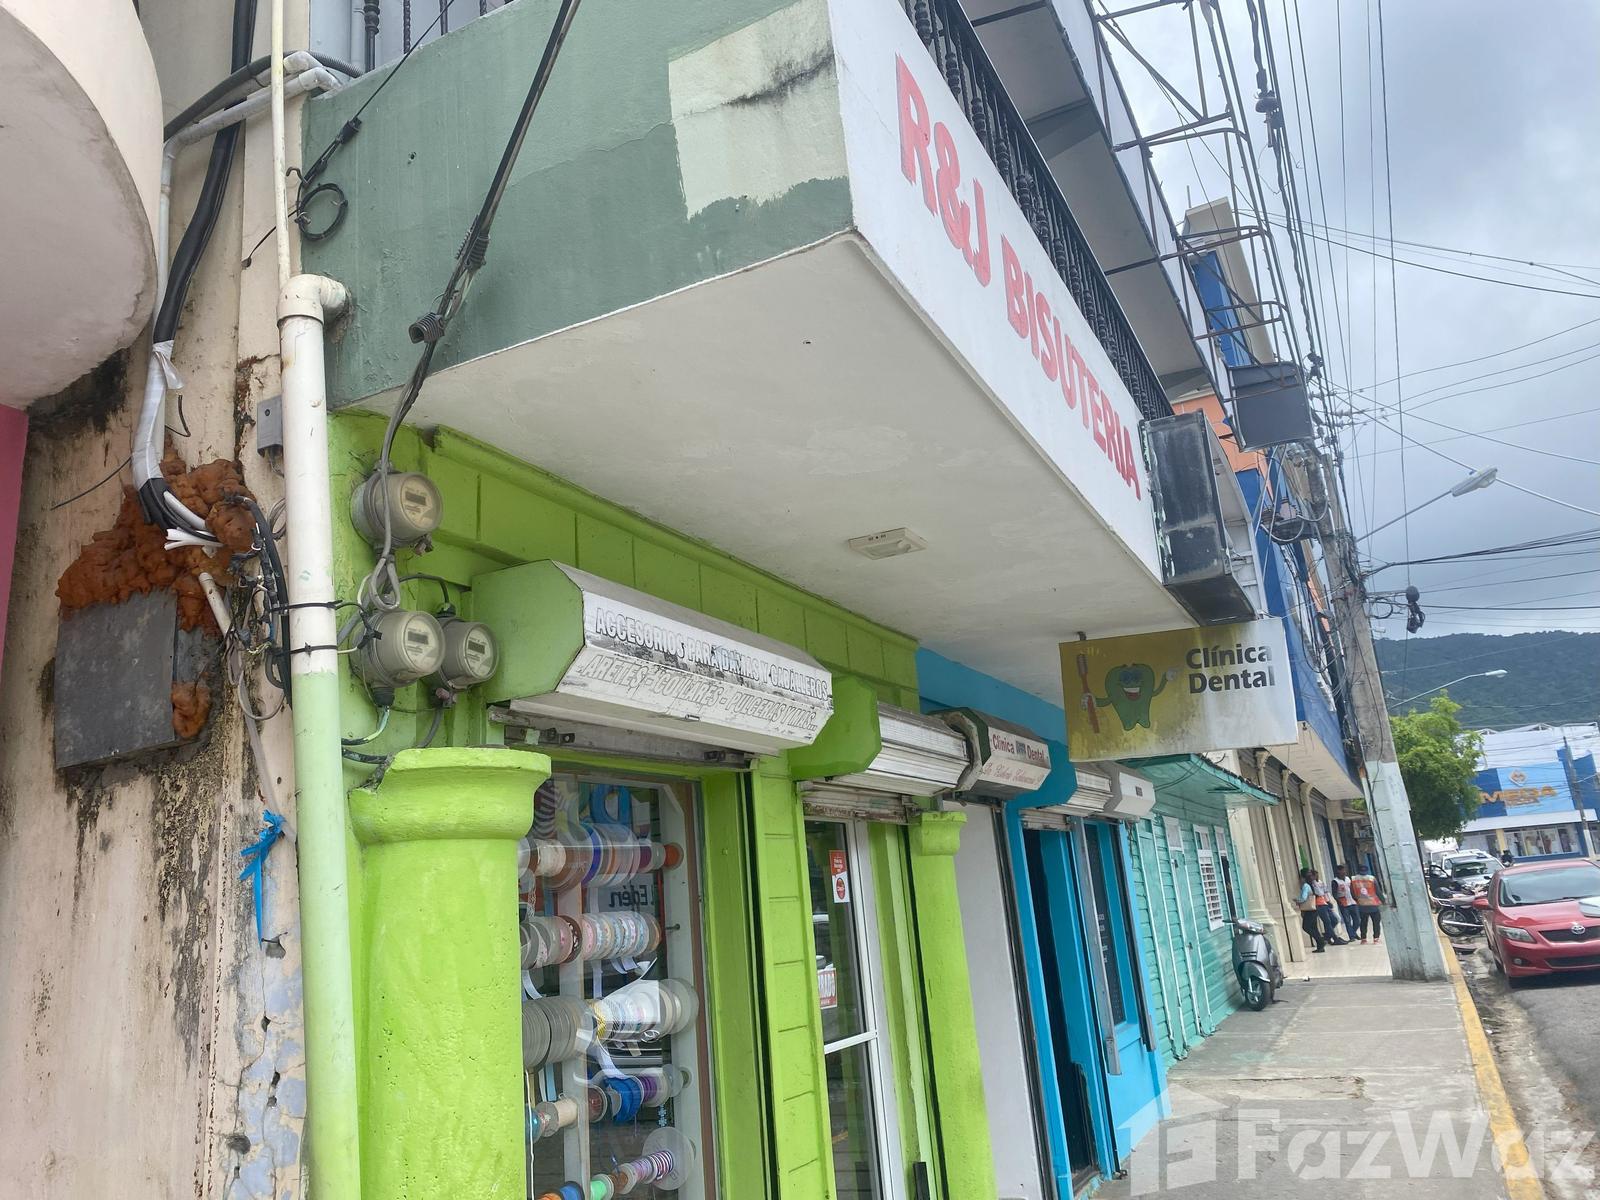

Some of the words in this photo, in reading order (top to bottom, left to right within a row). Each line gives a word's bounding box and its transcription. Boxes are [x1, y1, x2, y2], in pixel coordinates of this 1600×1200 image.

[895, 53, 991, 288] R&J
[1000, 233, 1142, 501] BISUTERIA
[581, 654, 649, 689] ARETES
[596, 607, 686, 659] ACCESORIOS
[769, 663, 828, 701] CABALLEROS
[1185, 643, 1273, 671] Clínica
[1188, 667, 1276, 695] Dental
